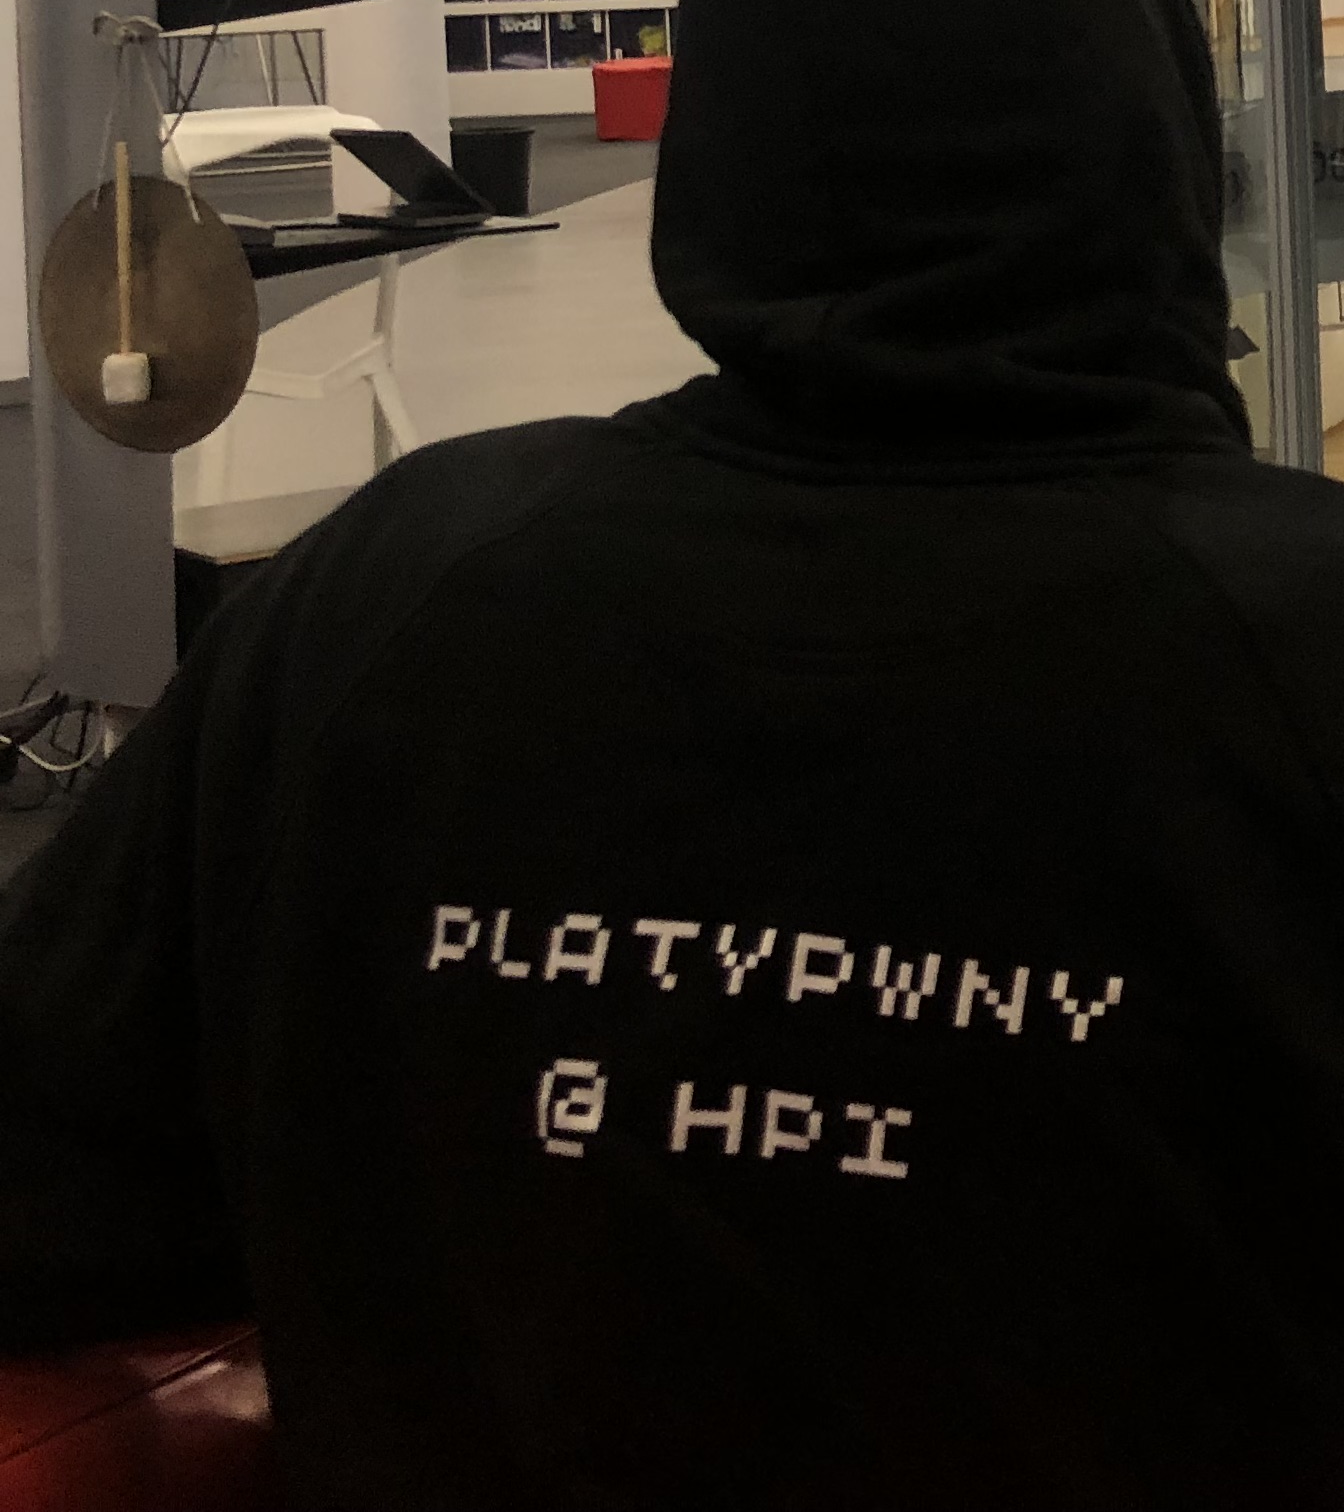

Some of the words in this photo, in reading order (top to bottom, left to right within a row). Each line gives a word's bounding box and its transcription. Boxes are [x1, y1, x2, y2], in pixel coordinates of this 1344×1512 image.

[427, 904, 1124, 1042] PLATYPWNY
[538, 1057, 608, 1158] @
[670, 1082, 912, 1179] HPI
